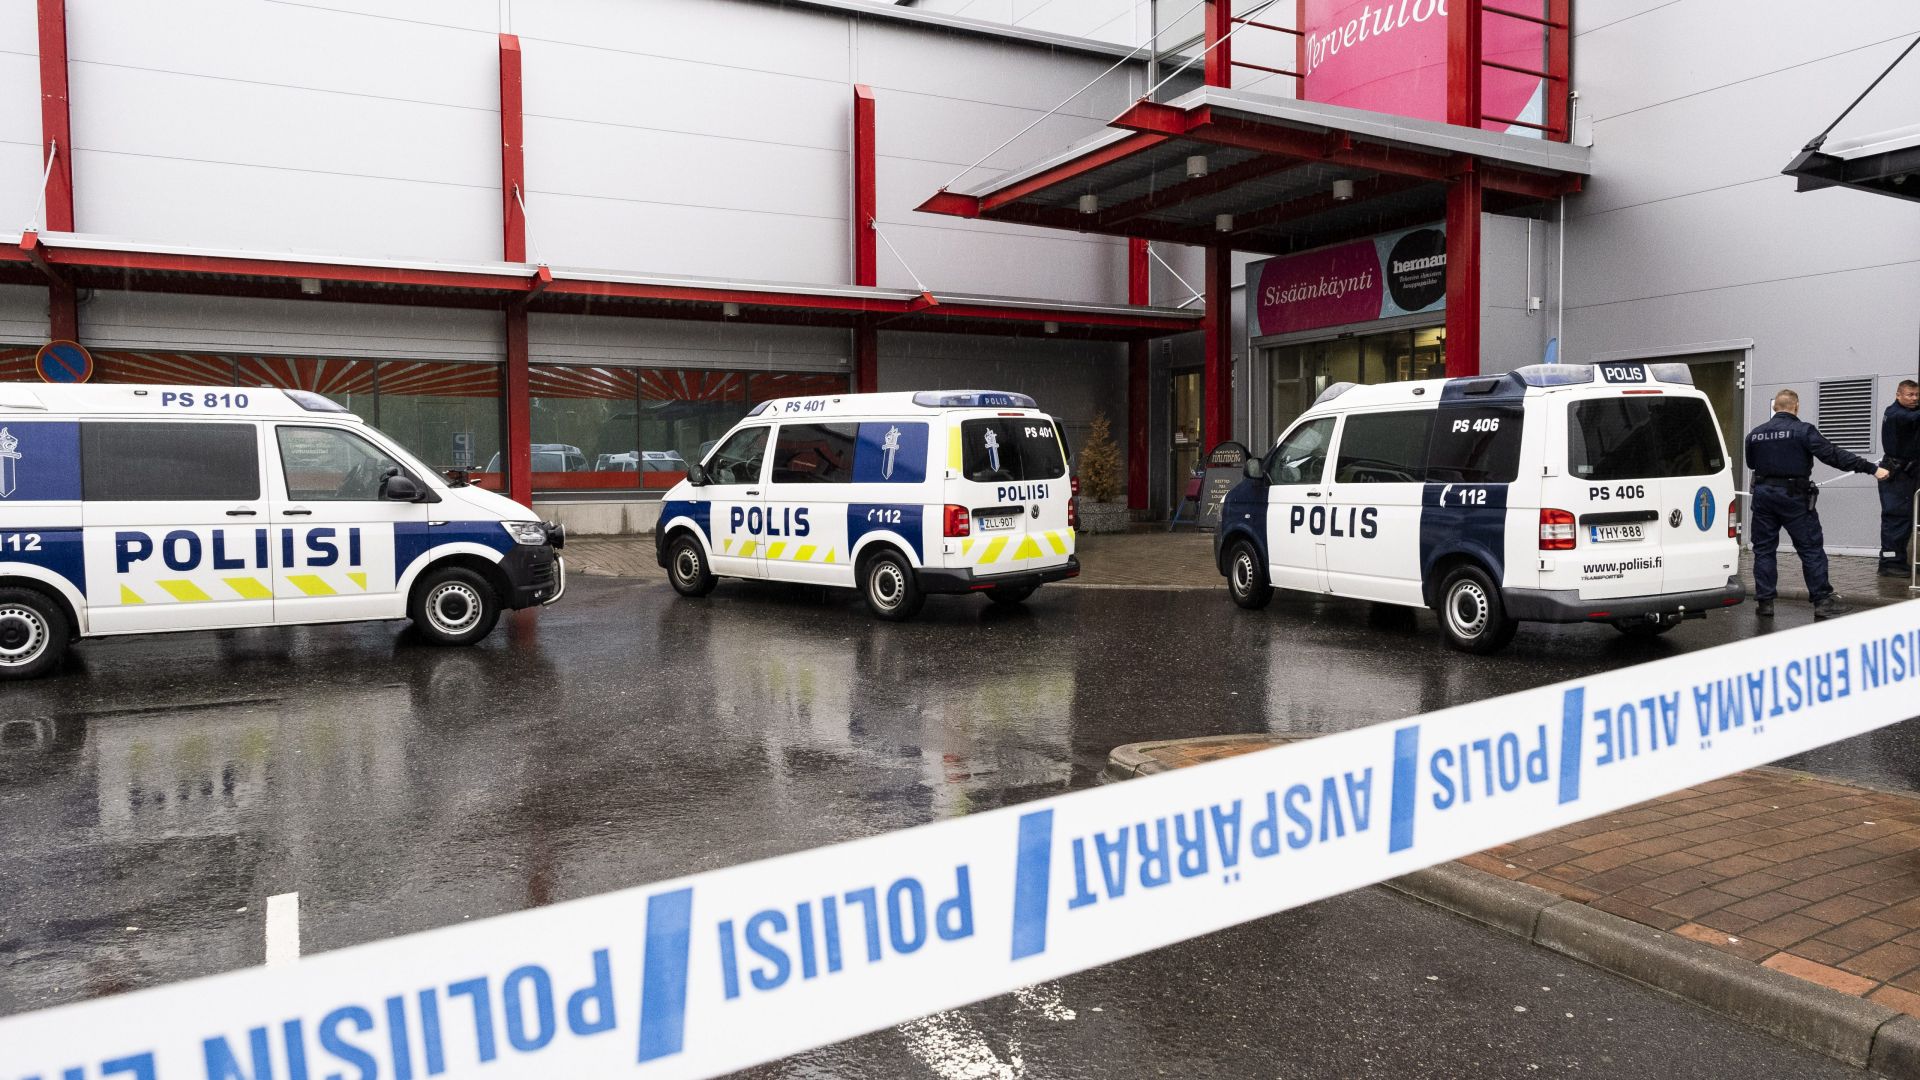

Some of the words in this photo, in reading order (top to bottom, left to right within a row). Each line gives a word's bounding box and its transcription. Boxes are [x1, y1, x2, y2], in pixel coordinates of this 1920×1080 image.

[1306, 0, 1448, 77] Tervetulo
[1264, 268, 1373, 306] Sisäänkäynti
[1605, 367, 1643, 381] POLIS
[162, 391, 194, 408] PS
[204, 392, 249, 409] 810
[785, 401, 801, 413] PS
[804, 400, 826, 412] 401
[984, 396, 1008, 406] POLIS
[1024, 426, 1037, 438] PS
[1038, 426, 1053, 438] 401
[1452, 419, 1471, 433] PS
[1473, 417, 1499, 432] 406
[1751, 430, 1790, 441] POLIISI
[998, 484, 1049, 502] POLIISI
[1459, 489, 1486, 505] 112
[1589, 487, 1611, 501] PS
[1615, 485, 1645, 500] 406
[730, 506, 810, 537] POLIS
[876, 509, 901, 524] 112
[985, 517, 1013, 528] ZLL-907
[1290, 505, 1378, 539] POLIS
[1598, 526, 1642, 539] YHY-888
[0, 534, 42, 551] 12
[115, 527, 362, 574] POLIISI
[1583, 556, 1662, 573] www.poliisi.fi
[1860, 629, 1920, 690] ISIN
[1692, 647, 1851, 750] ERISTÄMÄ
[1592, 691, 1681, 767] ALUE
[1429, 724, 1550, 811] POLIS
[1067, 767, 1373, 910] AVSPÄRRAT
[717, 863, 975, 1001] POLIISI
